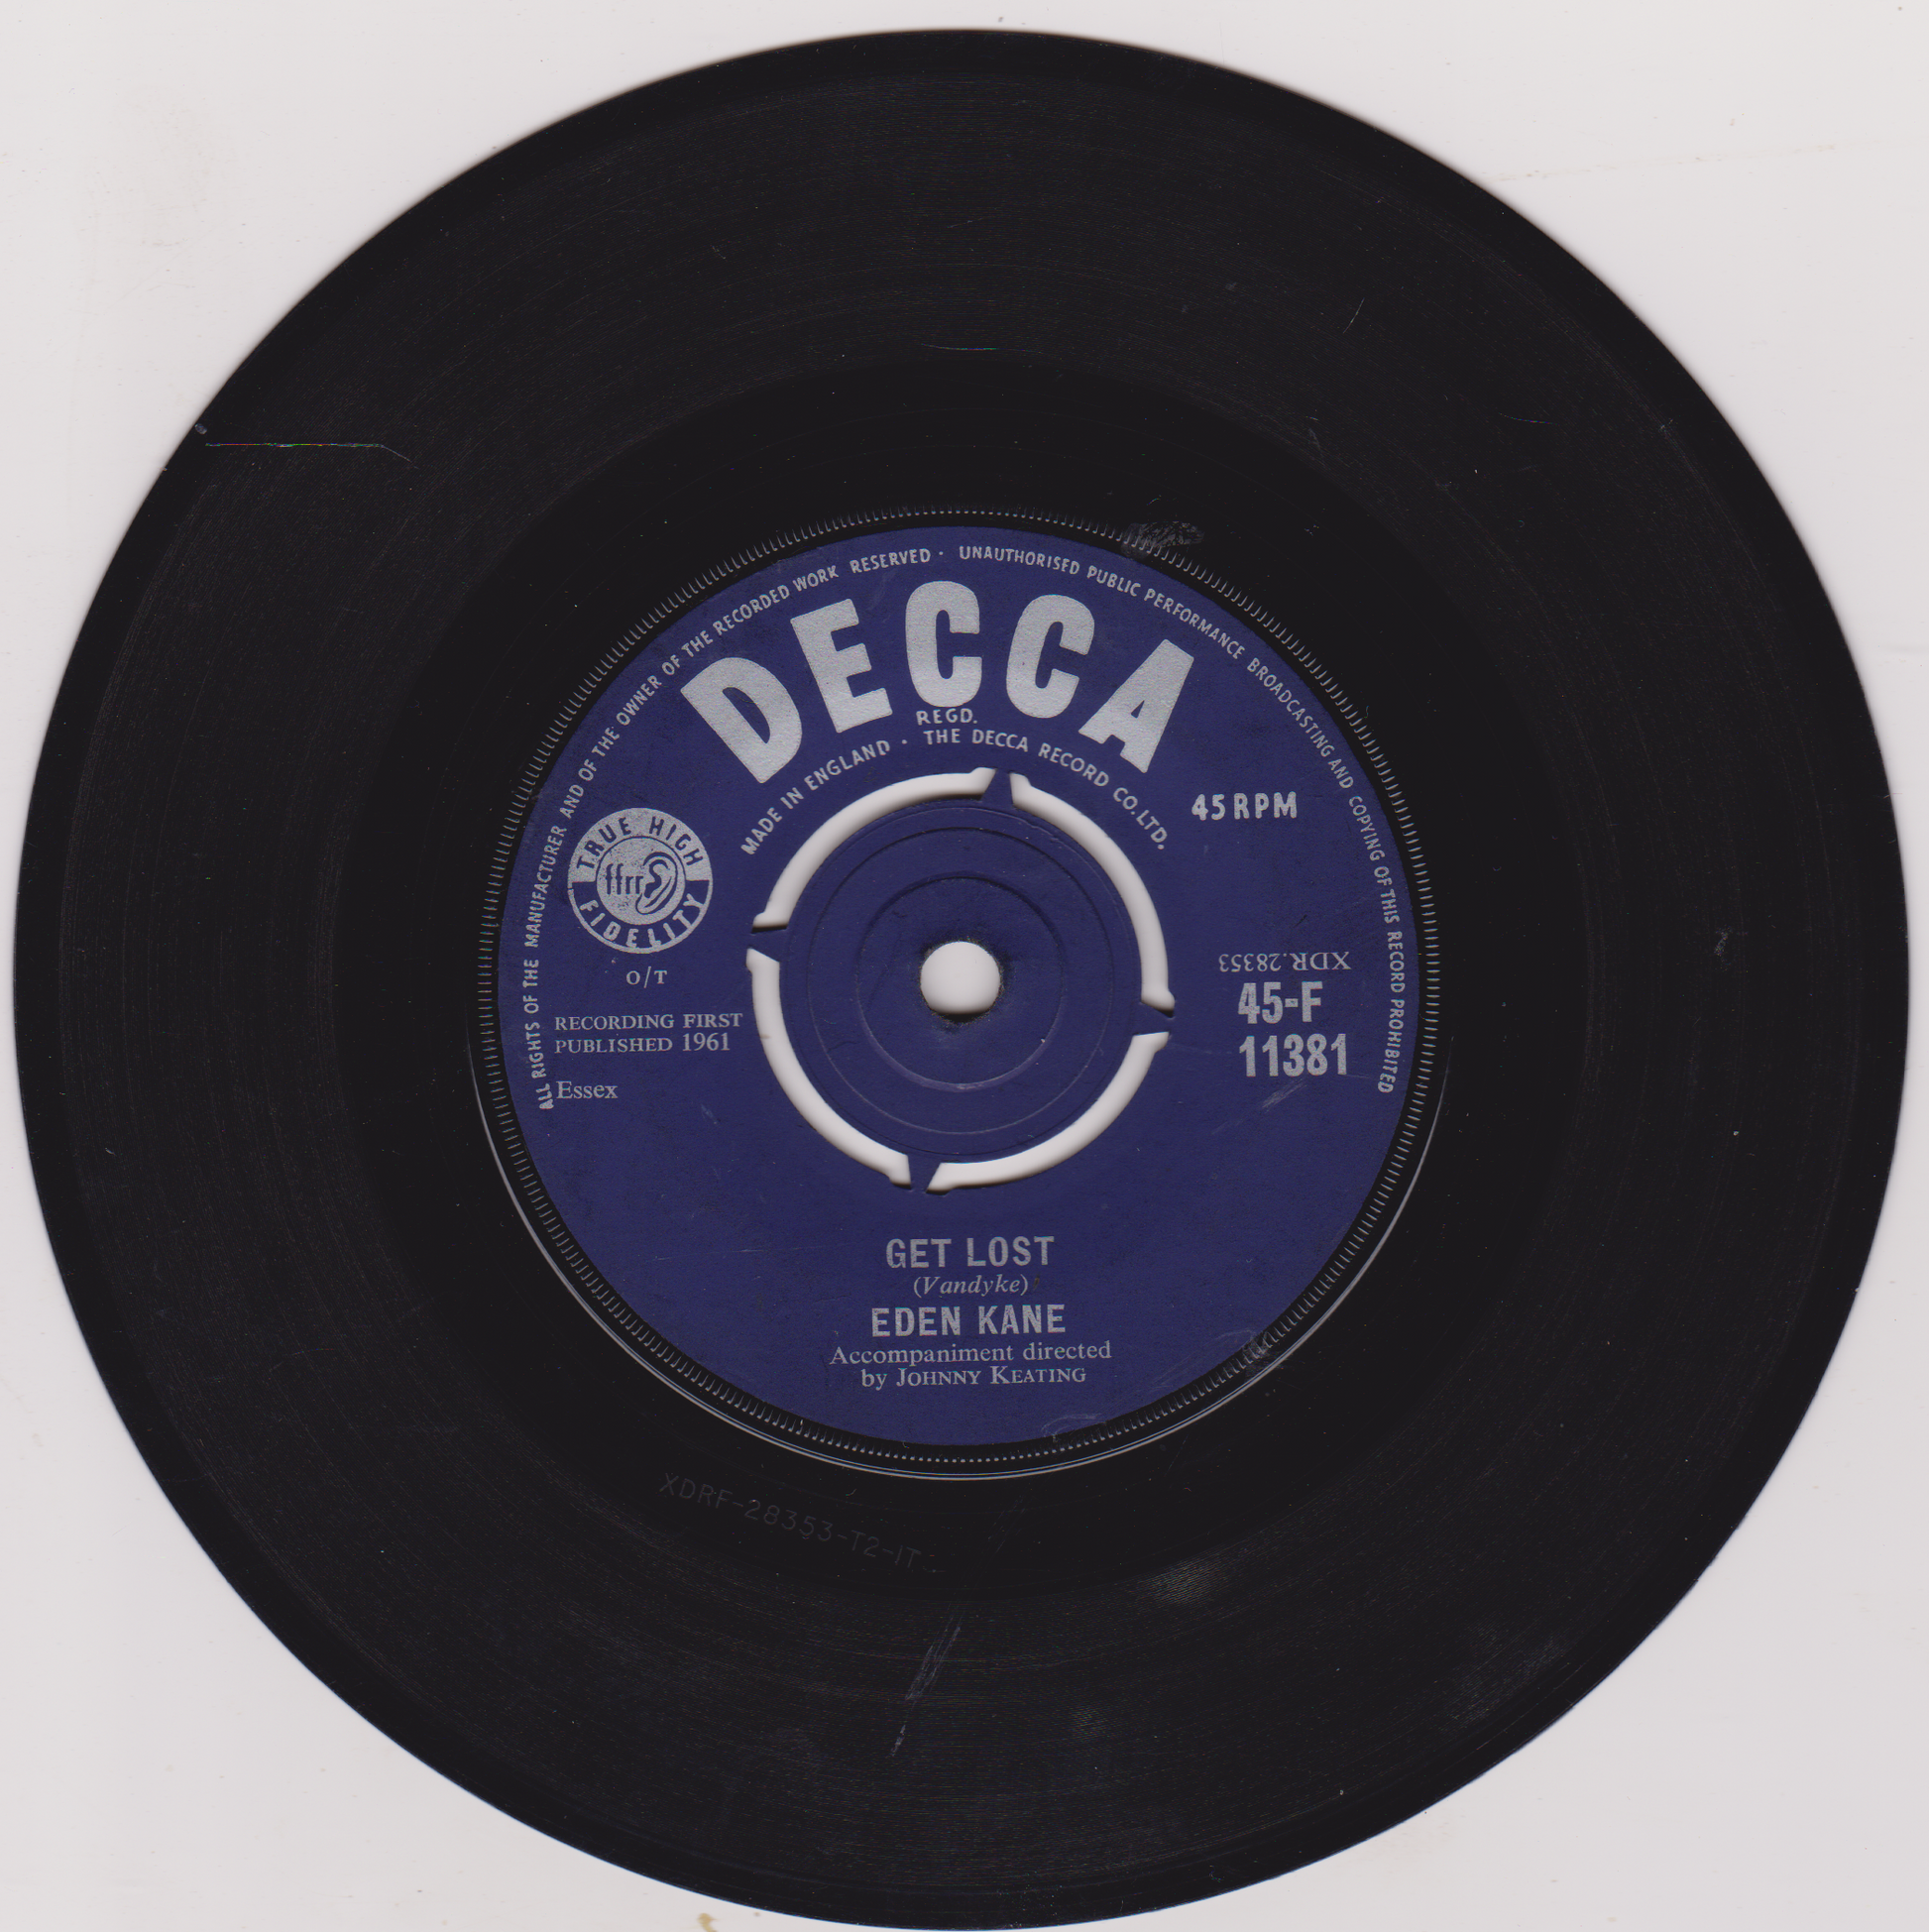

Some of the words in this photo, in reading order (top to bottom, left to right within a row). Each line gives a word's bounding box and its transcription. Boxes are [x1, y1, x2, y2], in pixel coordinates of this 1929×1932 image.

[850, 548, 932, 574] RESERVED
[959, 545, 1080, 575] UNAUTHORISED
[792, 565, 840, 593] WORK
[1086, 565, 1141, 597] PUBLIC
[712, 585, 790, 636] RECORDED
[1143, 588, 1246, 660] PERFORMANCE
[681, 630, 714, 658] THE
[661, 654, 681, 676] OF
[680, 580, 1194, 783] DECCA
[616, 675, 662, 727] OWNER
[916, 708, 977, 726] REGD.
[1246, 657, 1335, 758] BROADCASTING
[591, 727, 621, 757] THE
[923, 729, 961, 745] THE
[971, 729, 1029, 752] DECCA
[1038, 742, 1109, 787] RECORD
[578, 758, 597, 782] OF
[1327, 758, 1354, 789] AND
[559, 784, 584, 820] AND
[740, 807, 783, 855] MADE
[780, 787, 804, 810] IN
[804, 739, 890, 791] ENGLAND
[1191, 793, 1226, 822] 45
[1233, 791, 1298, 821] RPM
[577, 817, 631, 869] TRUE
[649, 817, 703, 865] HIGH
[1348, 796, 1386, 861] COPYING
[523, 826, 568, 948] MANUFACTURER
[606, 863, 644, 895] ffrr
[1374, 866, 1393, 886] OF
[580, 893, 704, 948] FIDELITY
[1380, 888, 1400, 924] THIS
[522, 959, 539, 988] THE
[625, 966, 668, 989] O/T
[1387, 931, 1406, 993] RECORD
[522, 995, 539, 1014] OF
[1237, 981, 1323, 1025] 45-F
[555, 1014, 675, 1031] RECORDING
[683, 1013, 742, 1029] FIRST
[524, 1022, 547, 1080] RIGHTS
[555, 1037, 673, 1054] PUBLISHED
[682, 1032, 731, 1052] 1961
[1239, 1033, 1347, 1078] 11381
[1377, 998, 1406, 1093] PROHIBITED
[535, 1082, 560, 1110] ALL
[556, 1080, 619, 1100] Essex
[885, 1238, 952, 1269] GET
[966, 1236, 1055, 1268] LOST
[913, 1274, 1029, 1299] (Vandyke)
[871, 1306, 961, 1337] EDEN
[978, 1304, 1066, 1335] KANE
[829, 1343, 1014, 1367] Accompaniment
[1022, 1340, 1112, 1361] directed
[860, 1368, 887, 1391] by
[895, 1367, 982, 1387] JOHNNY
[990, 1365, 1086, 1385] KEATING
